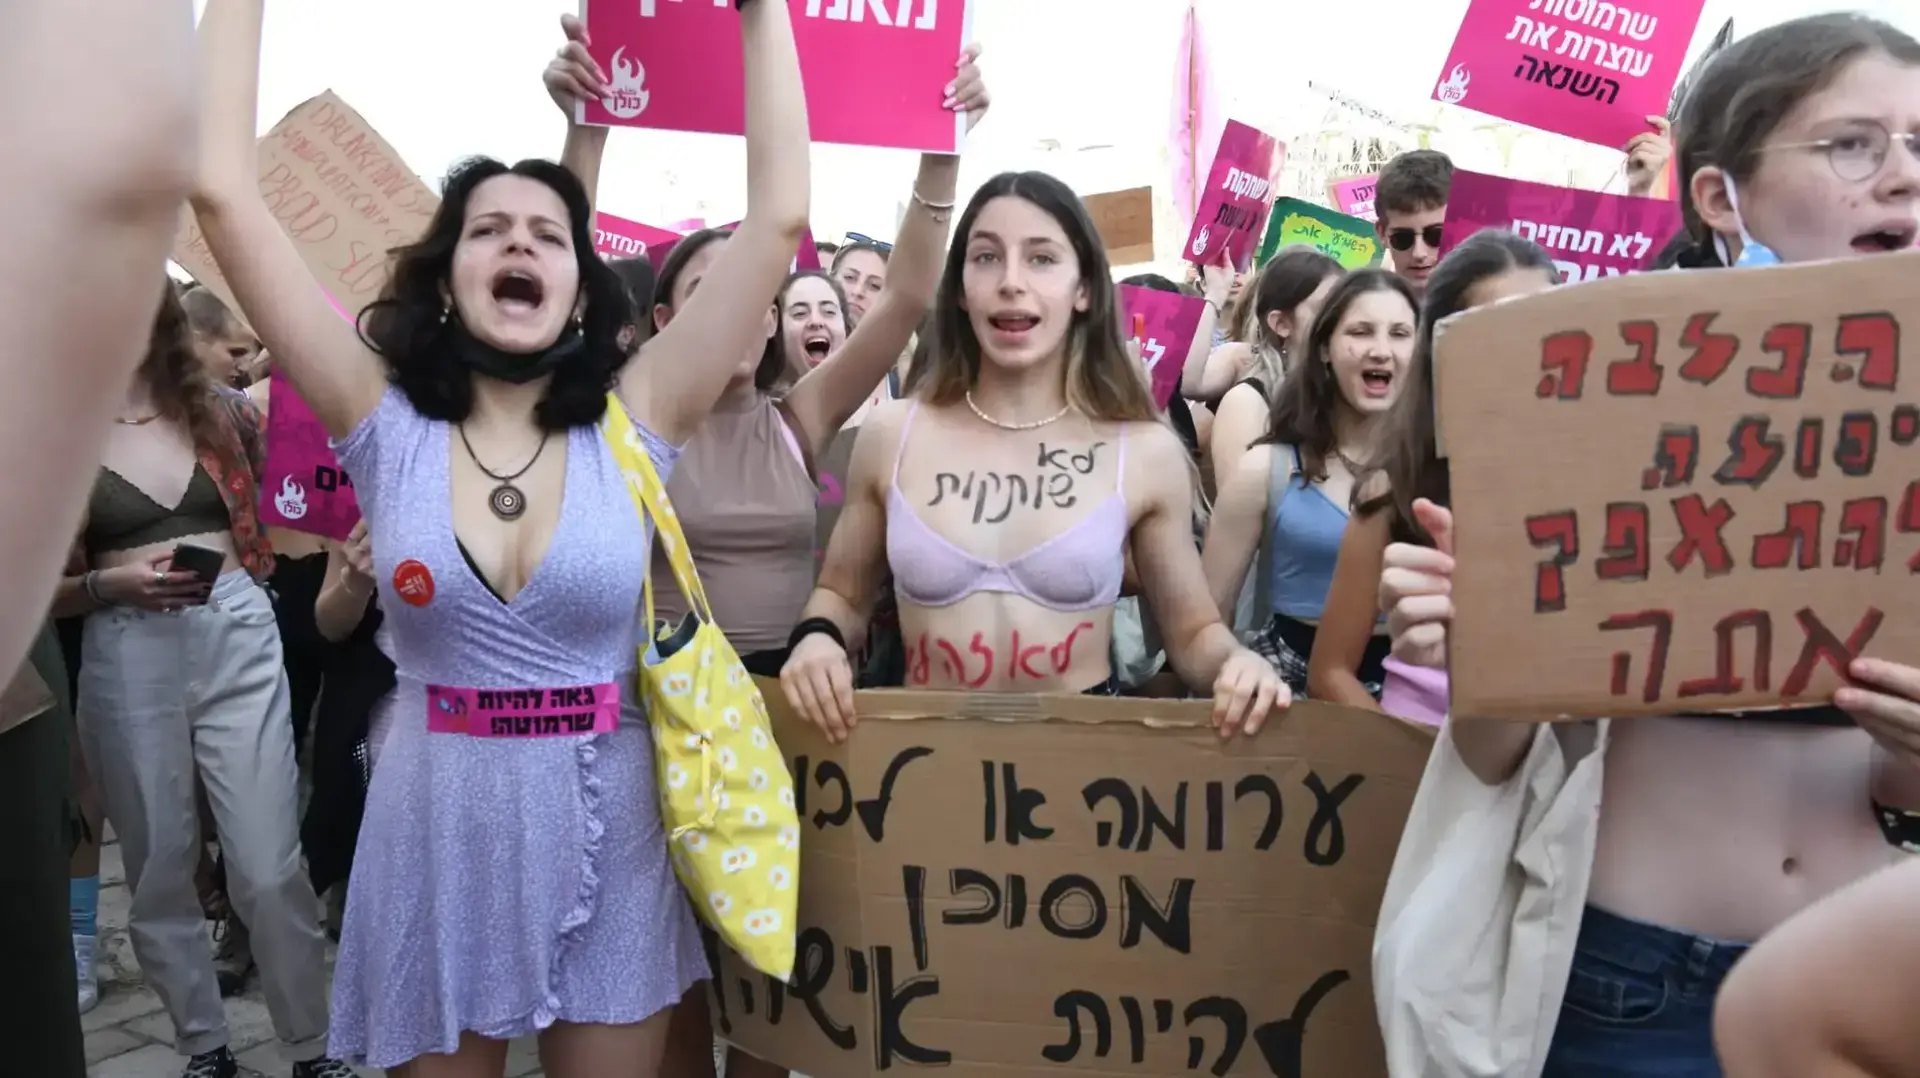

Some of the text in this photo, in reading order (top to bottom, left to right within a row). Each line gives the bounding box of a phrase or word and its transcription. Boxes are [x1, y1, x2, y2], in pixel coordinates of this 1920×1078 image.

[1505, 15, 1654, 77] עוצרות את
[613, 94, 642, 112] כולן
[1514, 54, 1620, 104] השנאה
[595, 228, 647, 256] תחזיר
[1511, 218, 1653, 260] לא תחזירו
[323, 241, 388, 294] SLU
[1536, 310, 1899, 400] הכלבה
[1037, 441, 1107, 474] לא
[926, 470, 1078, 525] שותקות
[1008, 621, 1094, 681] לא
[1597, 606, 1885, 707] אתה
[477, 686, 596, 710] גאה להיות
[491, 711, 596, 735] שרמוטה!
[795, 745, 1366, 867] ערומה או לבו
[902, 864, 1196, 971] מסוכן
[1041, 969, 1350, 1078] להיות
